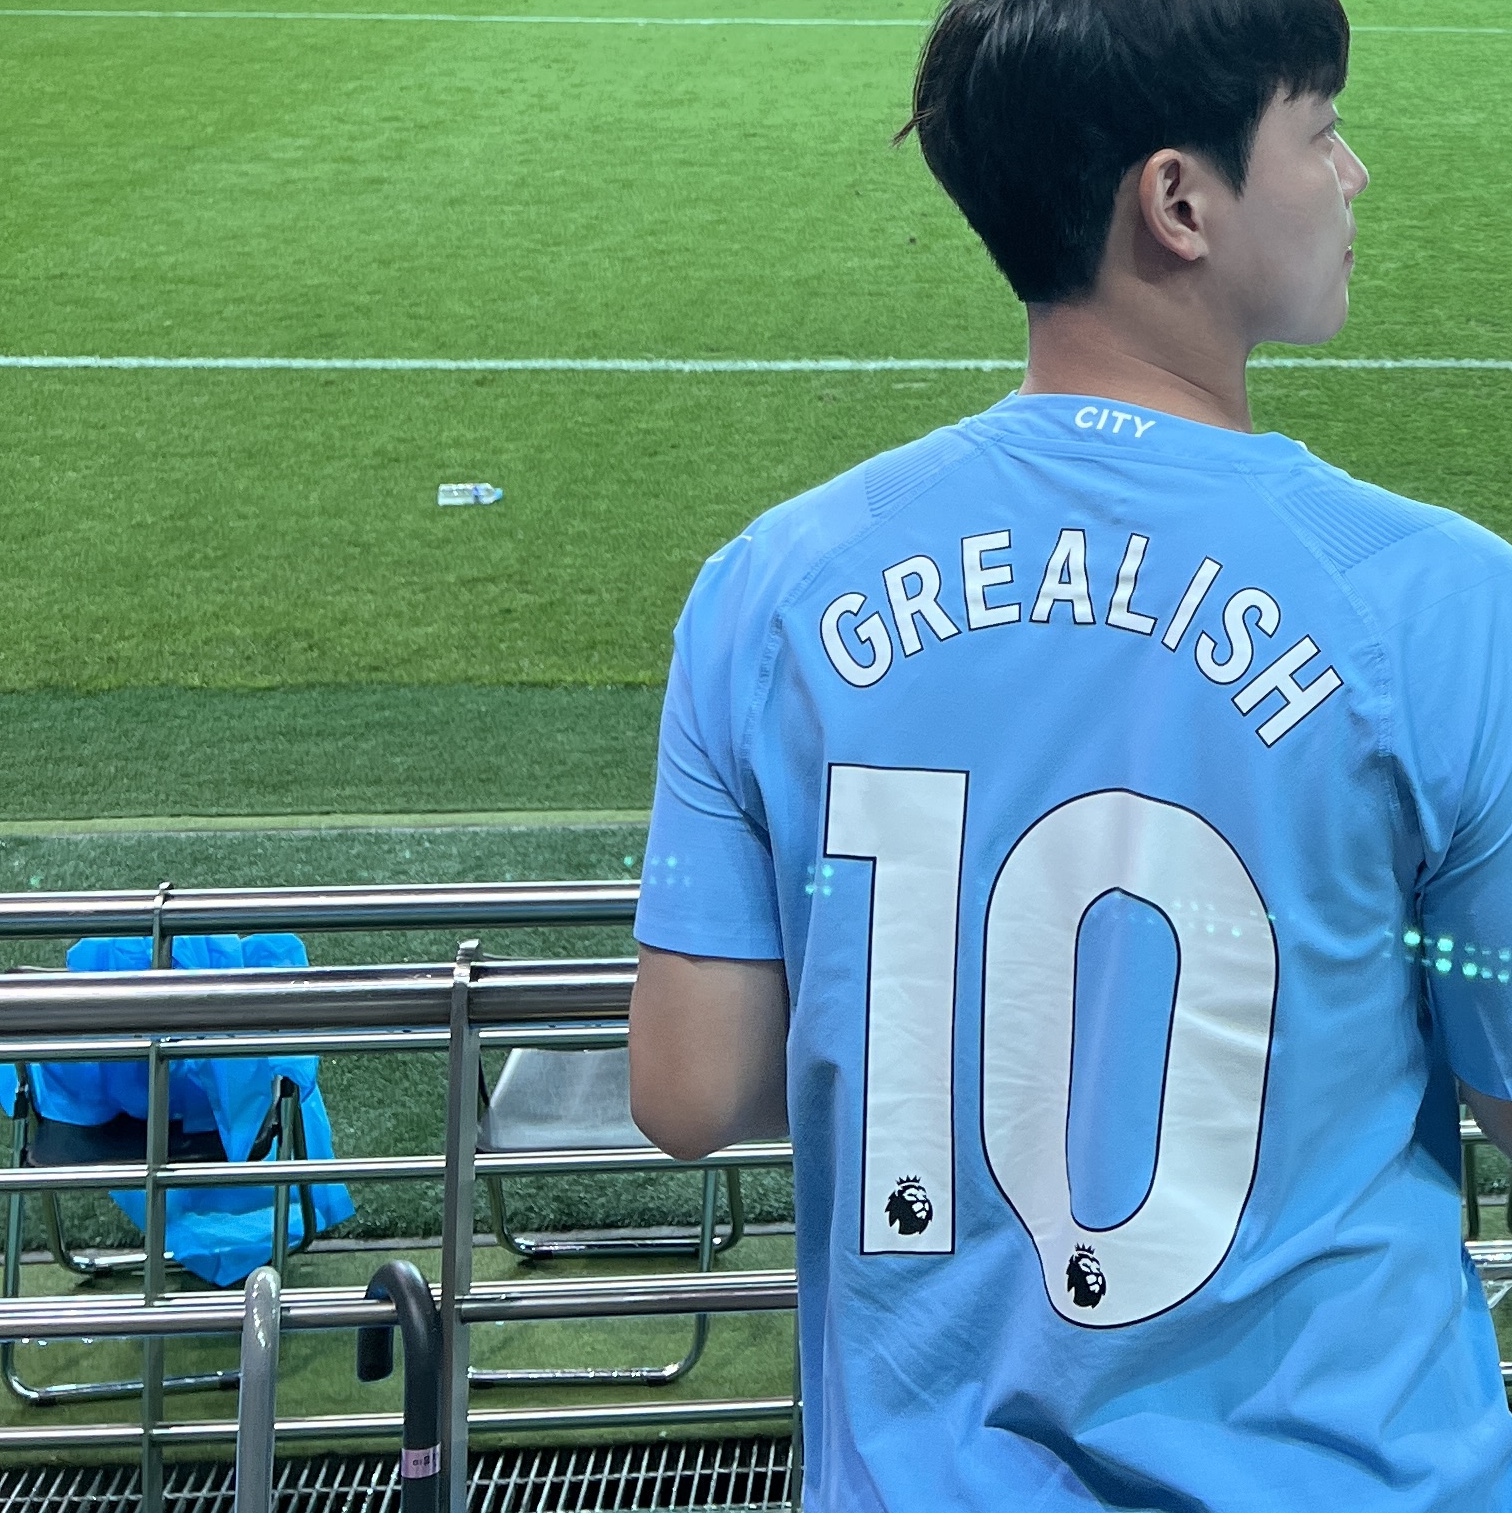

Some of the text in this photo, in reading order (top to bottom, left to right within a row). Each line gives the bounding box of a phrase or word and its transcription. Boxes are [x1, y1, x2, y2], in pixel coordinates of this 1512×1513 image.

[1073, 405, 1157, 439] CITY
[819, 527, 1344, 749] GREALISH
[823, 762, 1280, 1329] 10
